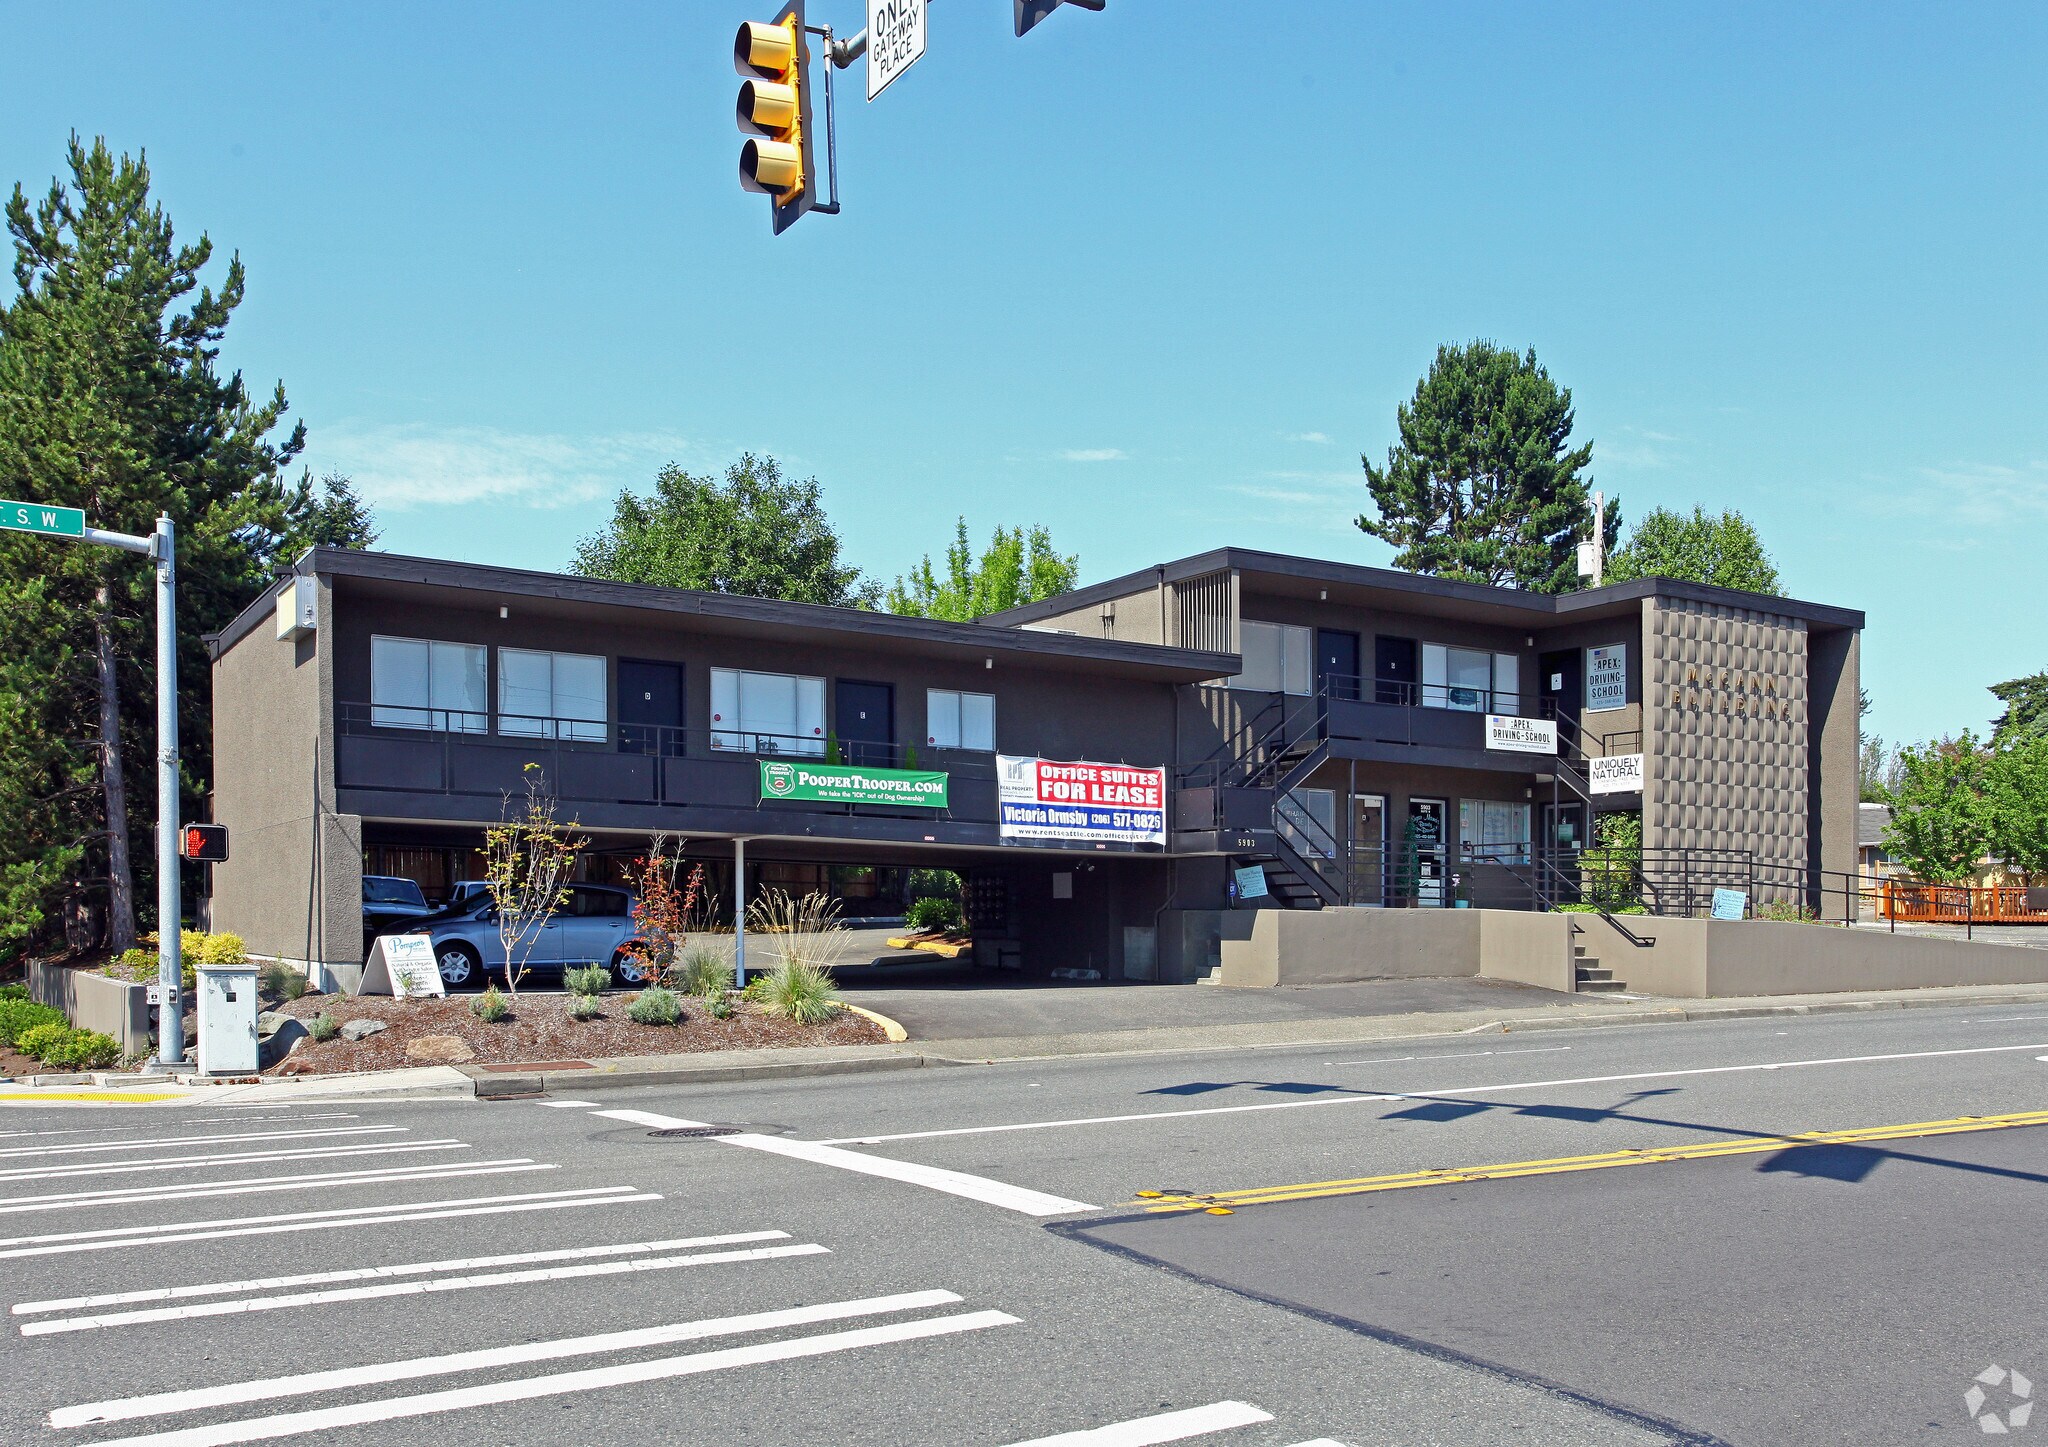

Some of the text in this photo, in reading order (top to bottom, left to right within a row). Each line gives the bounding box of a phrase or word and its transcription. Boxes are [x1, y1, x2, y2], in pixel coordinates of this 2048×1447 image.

[877, 0, 912, 37] ONL
[874, 5, 919, 62] GATEWAY
[880, 34, 912, 78] PLACE
[1592, 685, 1623, 698] SCHOOL
[1674, 691, 1789, 716] BUILDING
[1493, 729, 1550, 743] DRIVING-SCHOOL
[1592, 767, 1640, 780] NATURAL
[1594, 757, 1640, 770] UNIQUELY
[1040, 766, 1158, 785] OFFICE SUITES
[884, 793, 896, 801] Dog
[896, 794, 925, 803] Ownership!
[1041, 781, 1158, 804] FOR LEASE
[1004, 806, 1047, 823] Victoria
[1047, 808, 1088, 827] Ormsby
[1091, 813, 1111, 824] (206)
